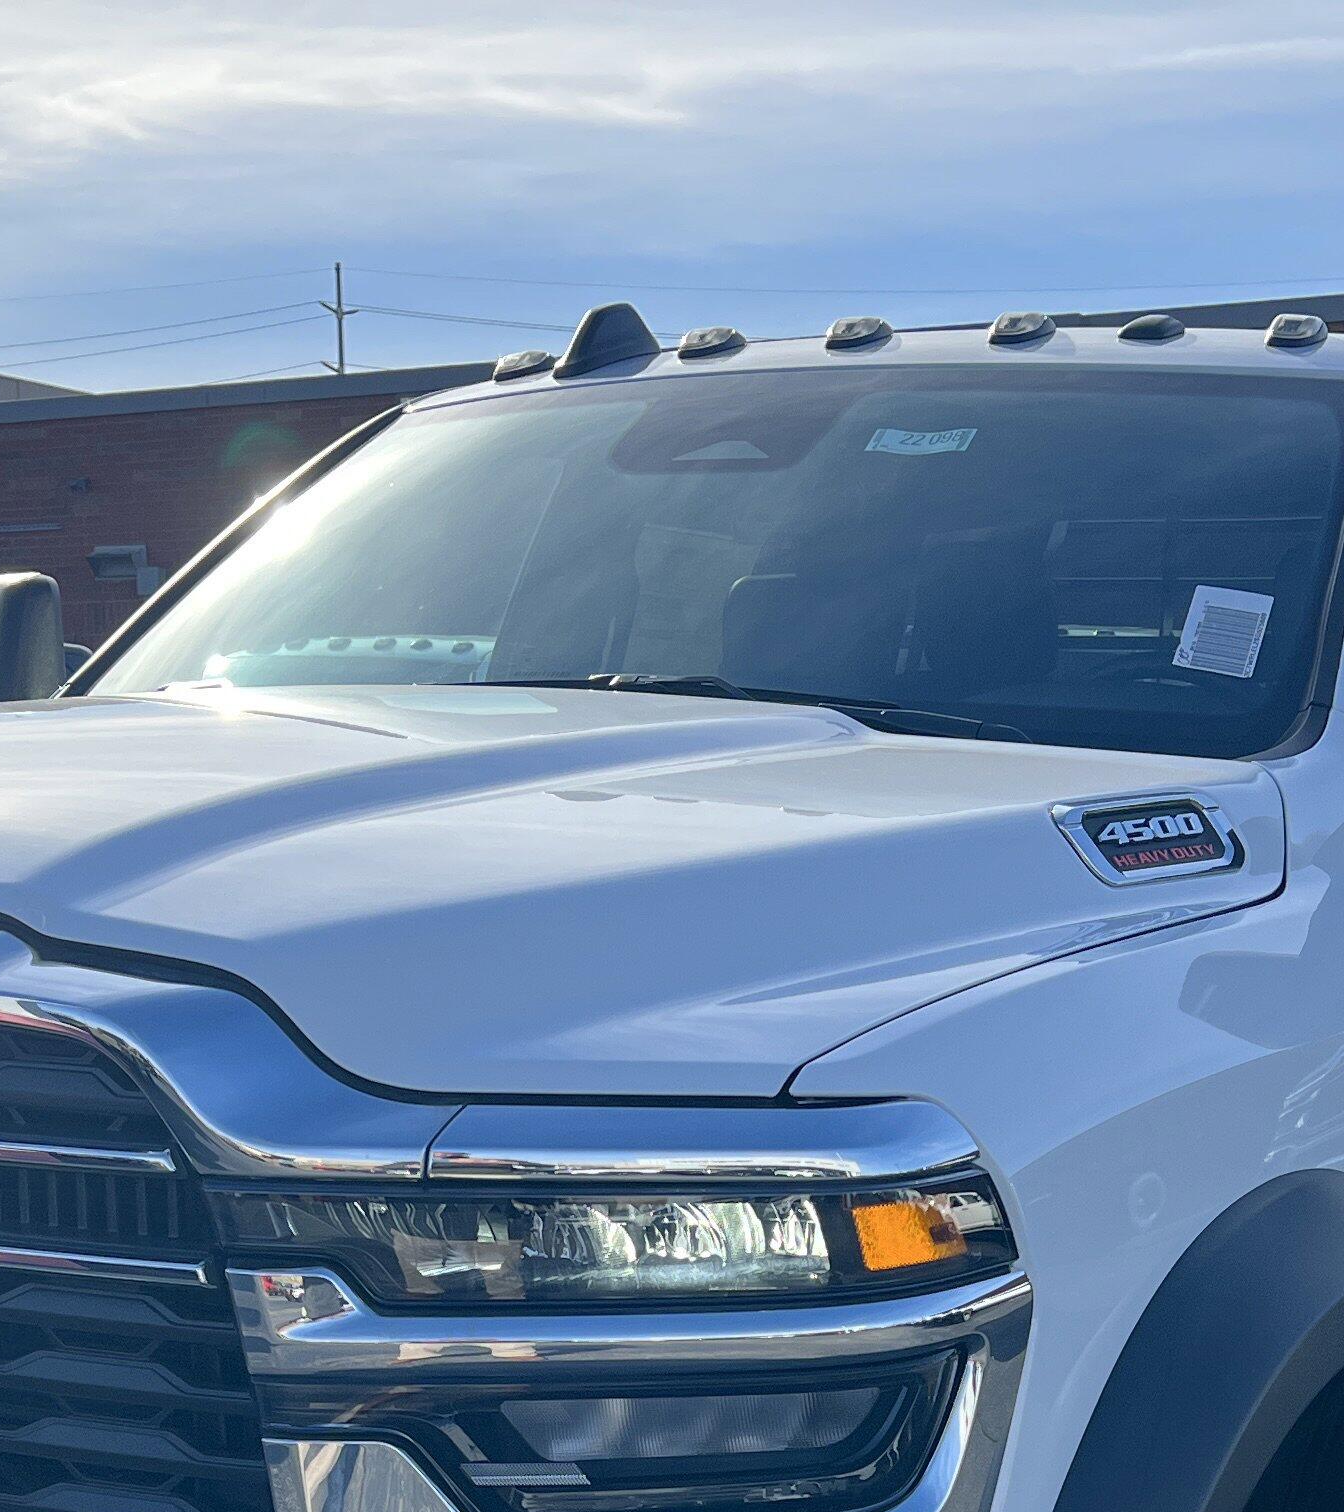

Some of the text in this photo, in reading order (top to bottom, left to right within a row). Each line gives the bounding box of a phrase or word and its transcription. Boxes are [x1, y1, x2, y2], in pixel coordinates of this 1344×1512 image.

[1099, 813, 1203, 845] 4500
[1113, 844, 1215, 867] HEAVY DUTY
